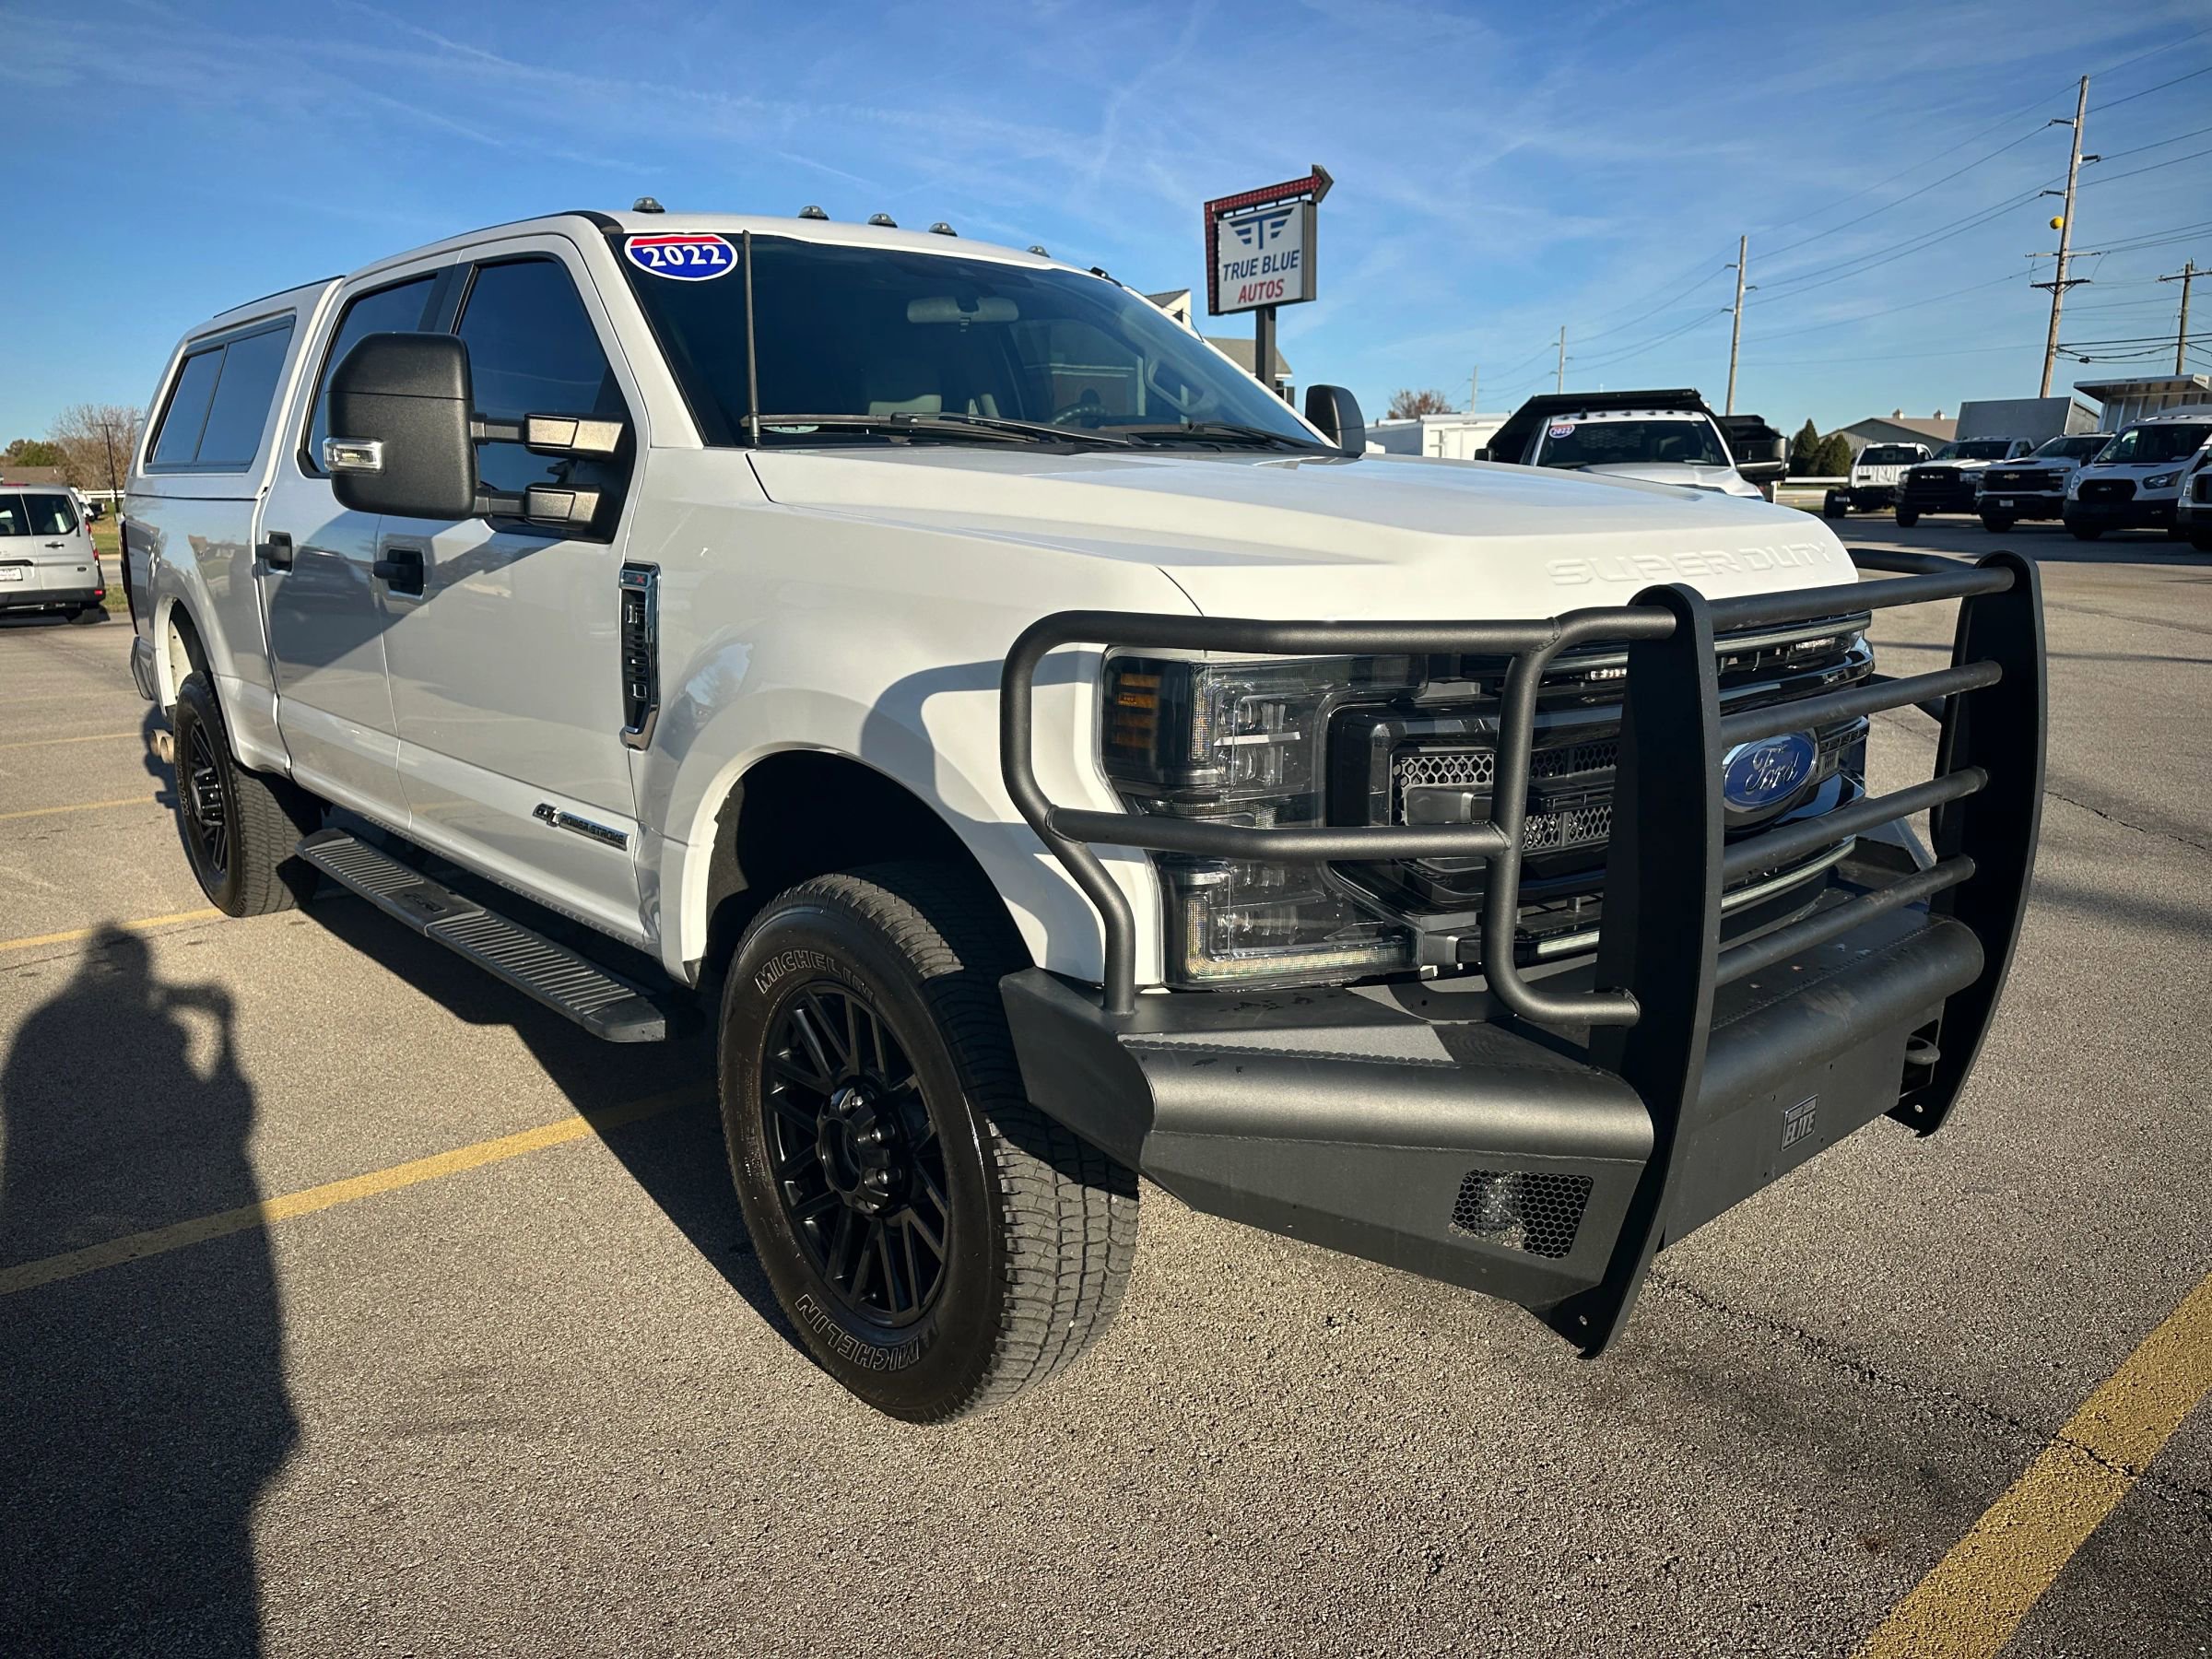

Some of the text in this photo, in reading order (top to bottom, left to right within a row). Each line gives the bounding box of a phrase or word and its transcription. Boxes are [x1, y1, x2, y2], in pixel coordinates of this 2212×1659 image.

[641, 245, 727, 267] 2022
[1223, 250, 1300, 282] TRUE BLUE
[1238, 278, 1285, 304] AUTOS
[1546, 541, 1832, 586] SUPER DUTY
[1745, 745, 1801, 795] Ford
[561, 813, 589, 832] POWER
[591, 823, 625, 845] STROKE
[754, 949, 875, 1004] MICHELIN
[1783, 1110, 1816, 1147] ELITE
[794, 1293, 921, 1371] MICHELIN
